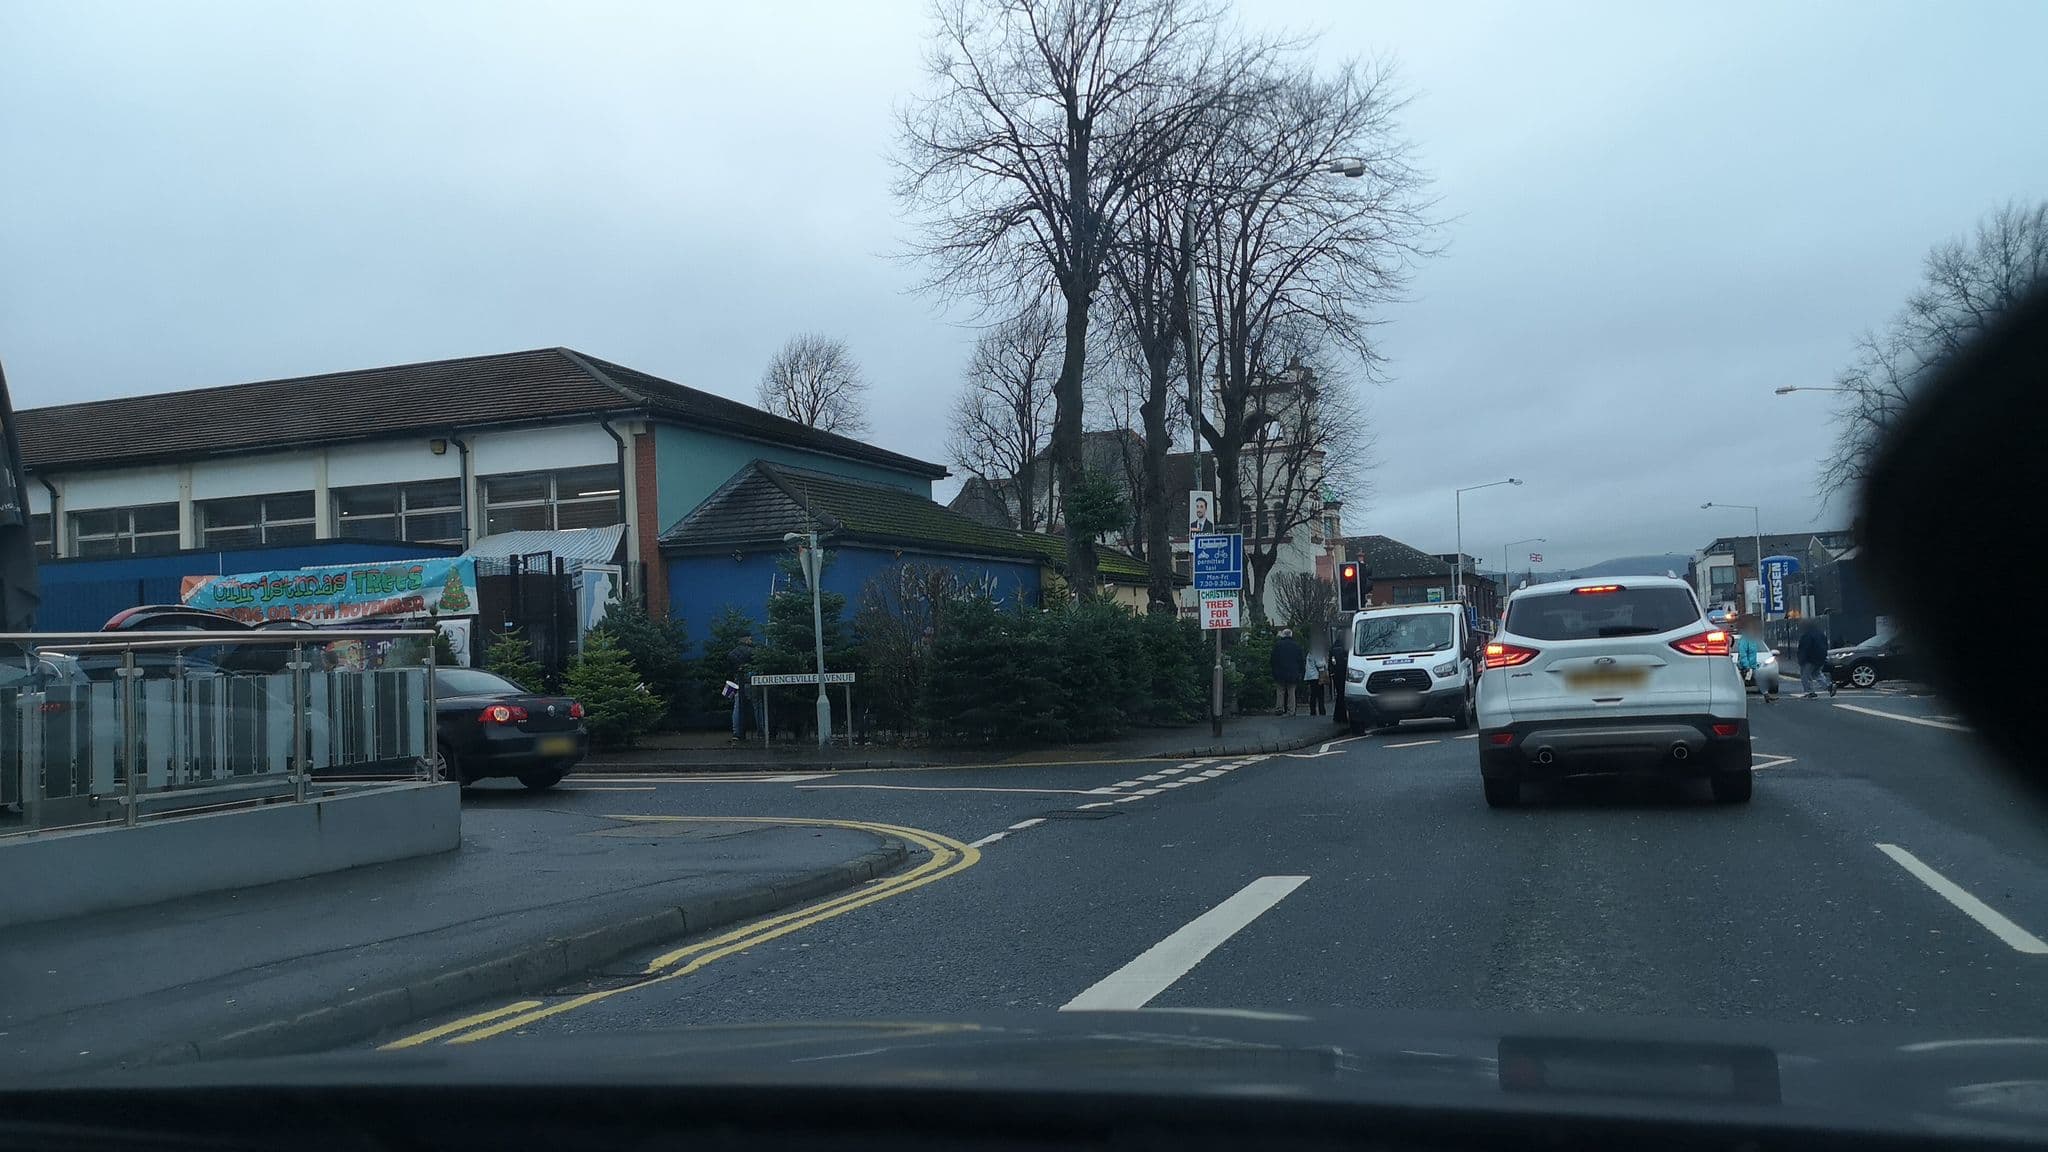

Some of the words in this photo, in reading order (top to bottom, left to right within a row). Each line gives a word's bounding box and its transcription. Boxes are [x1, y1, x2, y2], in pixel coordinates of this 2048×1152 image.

[1772, 562, 1784, 611] LARSEN
[1201, 590, 1237, 599] CHRISTMAS
[294, 602, 335, 620] 30TH
[338, 595, 426, 619] NOVEMBER
[1205, 600, 1234, 609] TREES
[1210, 610, 1228, 618] FOR
[1209, 619, 1232, 628] SALE
[753, 675, 817, 684] FLORENCEVILLE
[824, 673, 853, 682] VENUE
